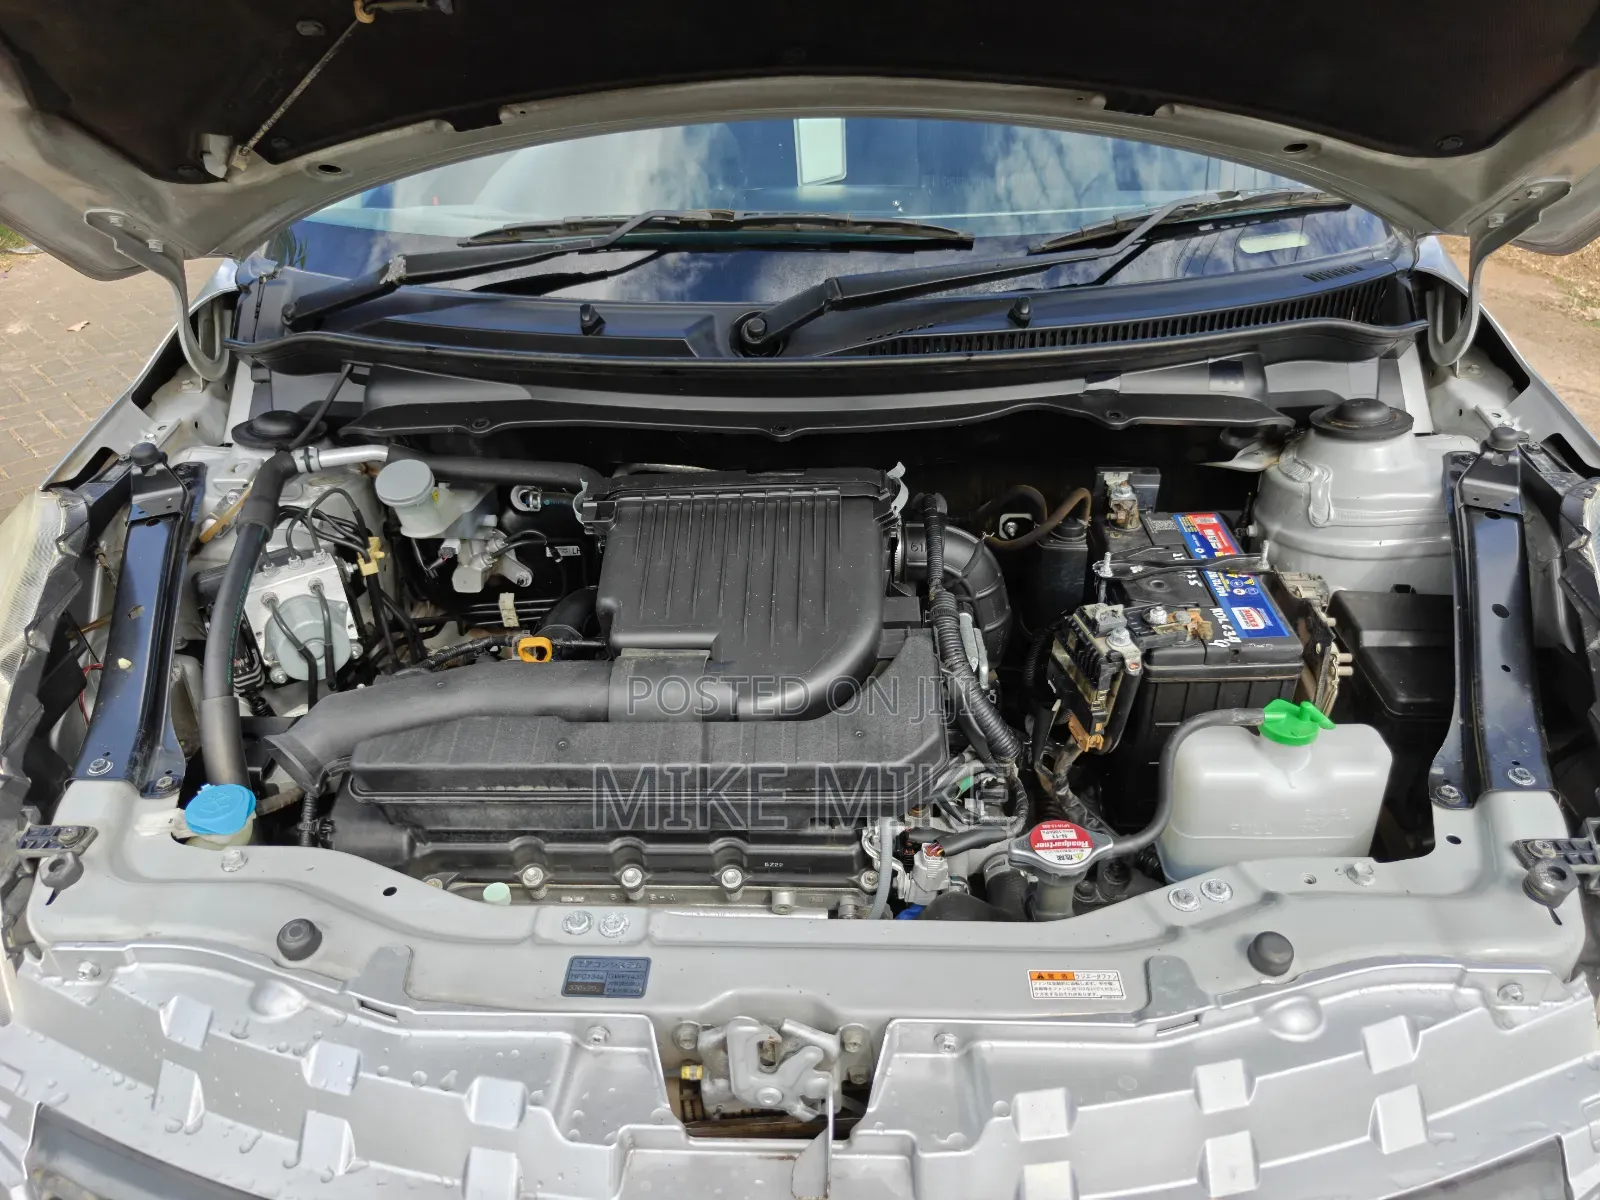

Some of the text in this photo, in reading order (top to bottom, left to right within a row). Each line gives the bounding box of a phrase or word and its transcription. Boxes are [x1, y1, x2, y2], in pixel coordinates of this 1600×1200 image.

[1242, 608, 1261, 628] EXIDE
[1034, 840, 1090, 849] Roadpartner
[578, 960, 642, 969] エアコンシステム
